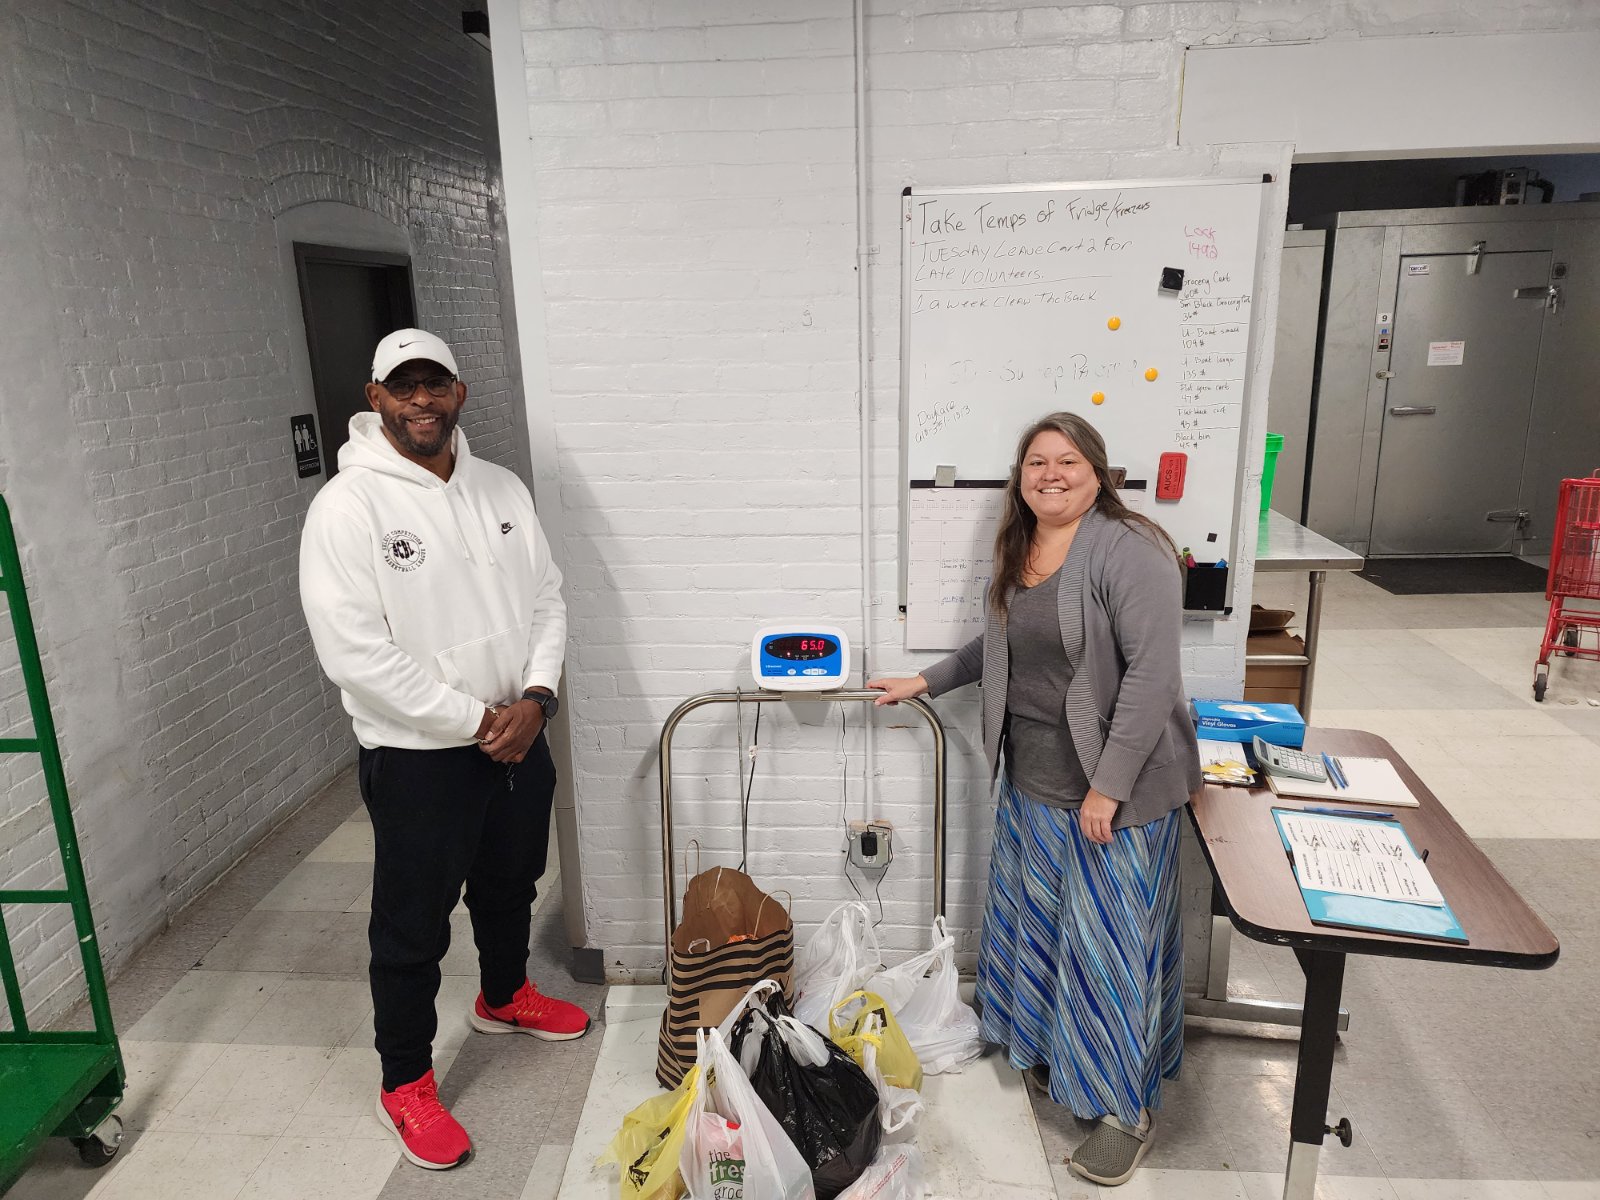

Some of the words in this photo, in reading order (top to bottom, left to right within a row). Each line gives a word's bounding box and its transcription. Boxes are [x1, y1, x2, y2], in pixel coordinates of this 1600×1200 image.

[918, 200, 966, 235] Take
[974, 202, 1027, 233] Temps
[1036, 199, 1055, 223] of
[1046, 238, 1084, 254] Cart
[1087, 239, 1098, 253] 2
[1103, 236, 1133, 251] For
[929, 298, 940, 310] a
[1382, 314, 1388, 322] 9
[801, 640, 825, 651] 65.0
[708, 1149, 731, 1164] the
